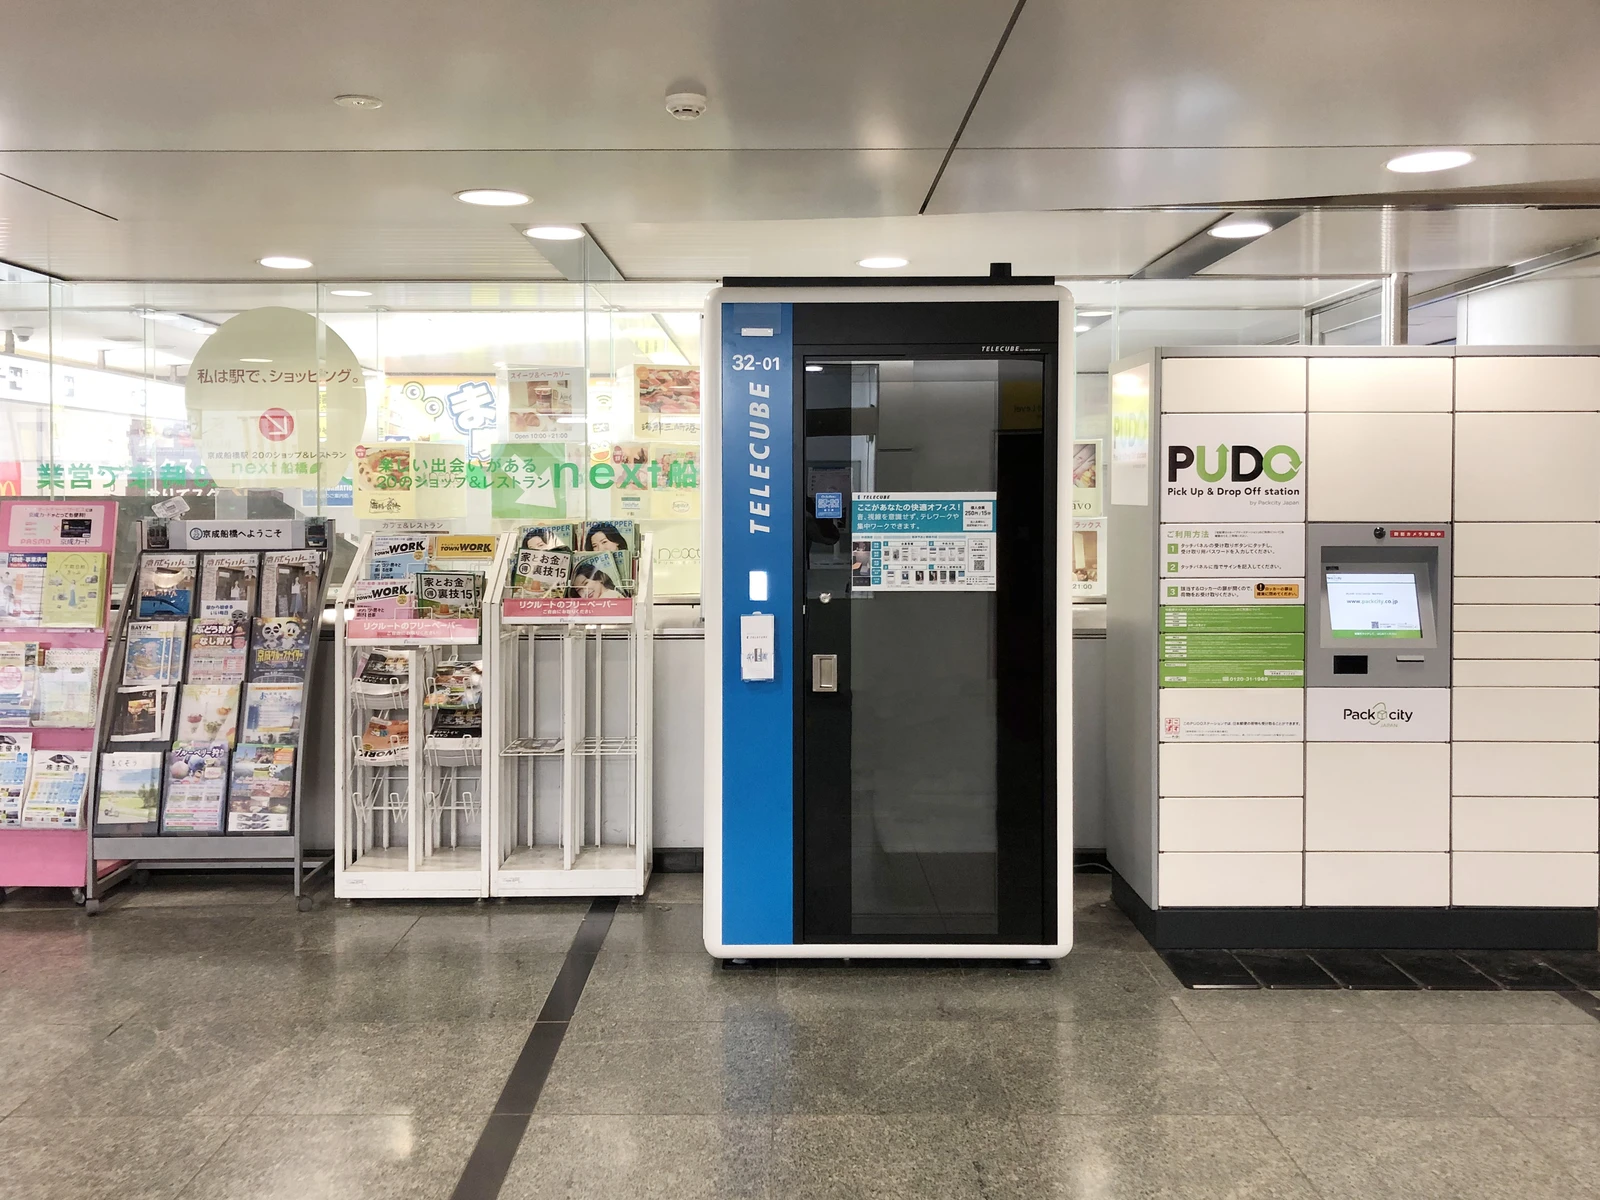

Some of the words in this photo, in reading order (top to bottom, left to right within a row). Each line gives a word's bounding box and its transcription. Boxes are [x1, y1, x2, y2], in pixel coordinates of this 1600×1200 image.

[732, 354, 780, 371] 32-01
[197, 368, 358, 384] 私は駅で、ショッピング。
[749, 382, 770, 534] TELECUBE
[1168, 444, 1303, 482] PUDO
[379, 458, 536, 472] 楽しい出会いがある
[376, 476, 551, 488] 20のショップ&レストラン
[1168, 487, 1187, 495] Pick
[1190, 488, 1204, 497] Up
[1217, 487, 1241, 497] Drop
[1244, 487, 1261, 495] Off
[1264, 487, 1300, 495] station
[202, 529, 282, 538] 京成船橋へようこそ
[1166, 530, 1210, 538] ご利用方法
[389, 540, 425, 554] WORK
[460, 543, 492, 553] WORK
[424, 578, 464, 588] 家とお金
[372, 584, 409, 598] WORK
[520, 601, 618, 609] リクルートのフリーペーパー
[199, 637, 232, 646] なし狩り
[1344, 708, 1375, 720] Pack
[1389, 708, 1413, 722] city
[175, 747, 225, 759] ブルーベリー狩り
